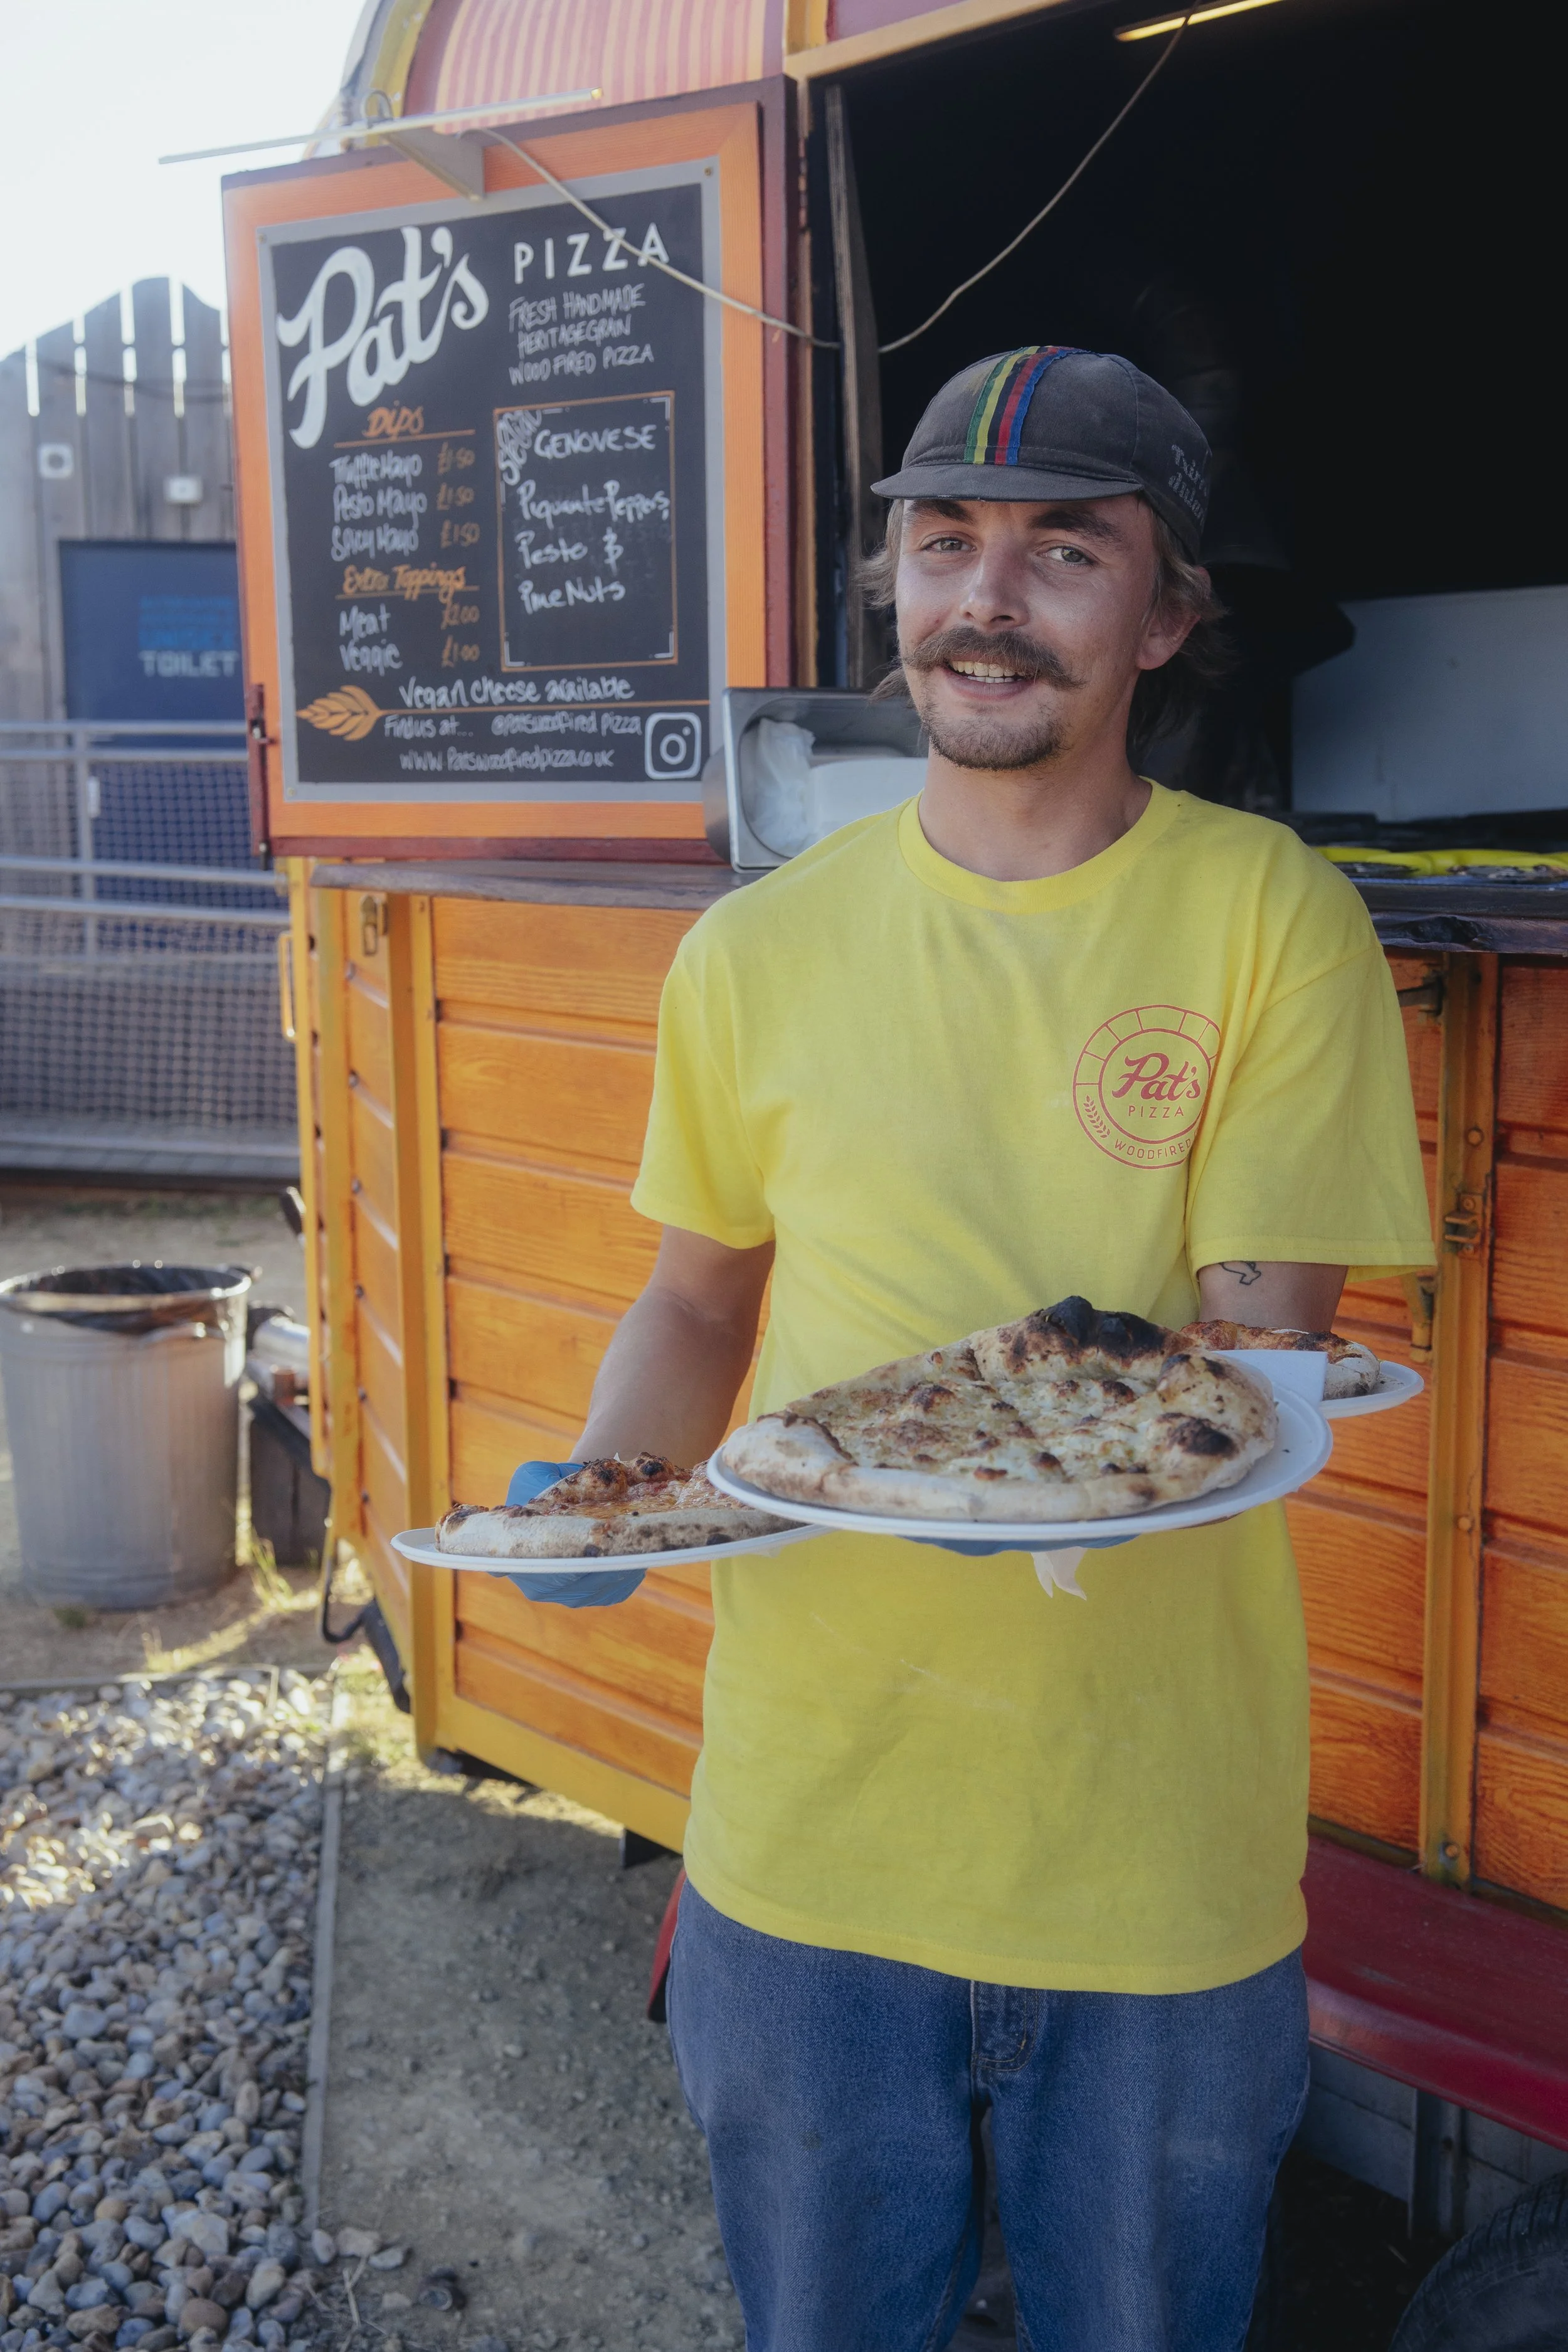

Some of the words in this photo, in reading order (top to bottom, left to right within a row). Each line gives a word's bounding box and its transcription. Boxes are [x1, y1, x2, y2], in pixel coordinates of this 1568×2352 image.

[514, 223, 670, 284] PIZZA
[508, 297, 557, 333] FRESH
[563, 283, 646, 319] HANDMADE
[276, 226, 489, 449] Pat's
[509, 358, 551, 386] WOOD
[553, 350, 596, 376] FIRED
[603, 344, 654, 369] PIZZA
[362, 400, 424, 441] Dips
[534, 425, 657, 459] GENOVESE
[377, 486, 427, 529] Mayo
[515, 530, 588, 569] Pesto
[339, 603, 391, 642] Meat
[139, 650, 238, 677] TOILET
[399, 675, 470, 711] Vegan
[1111, 1052, 1201, 1101] Pat's
[1128, 1105, 1185, 1119] PIZZA
[1115, 1138, 1192, 1160] WOODFIRED
